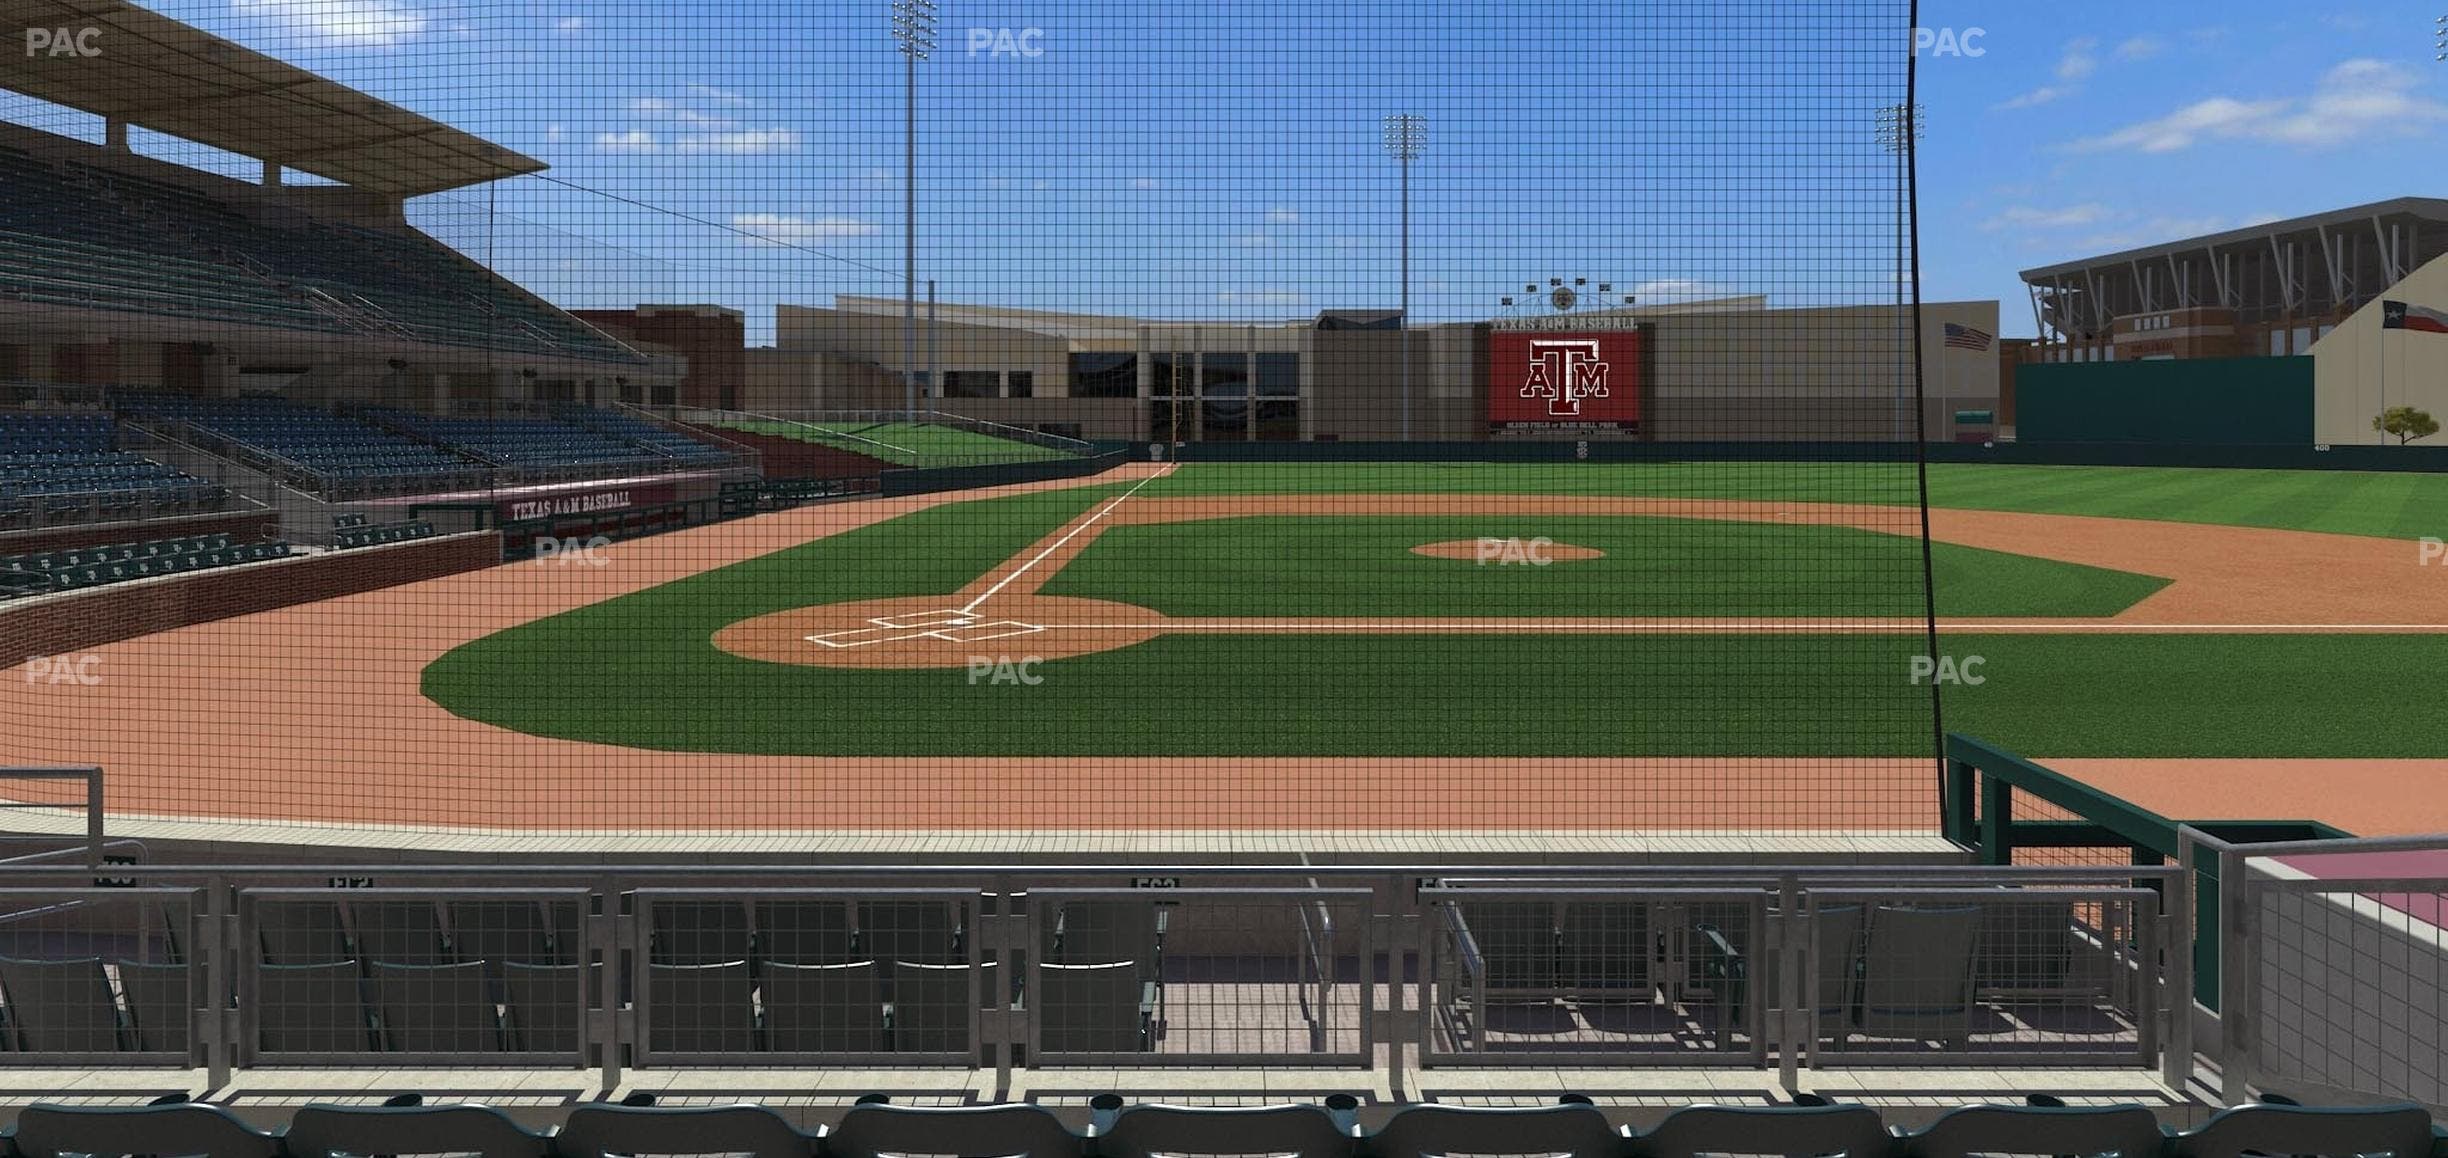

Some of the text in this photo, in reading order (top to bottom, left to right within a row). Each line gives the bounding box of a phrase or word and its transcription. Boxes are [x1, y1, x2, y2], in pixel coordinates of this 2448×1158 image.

[1492, 317, 1638, 331] TEXAS A&M BASEBALL
[512, 491, 631, 521] TEXAS A&M BASEBALL
